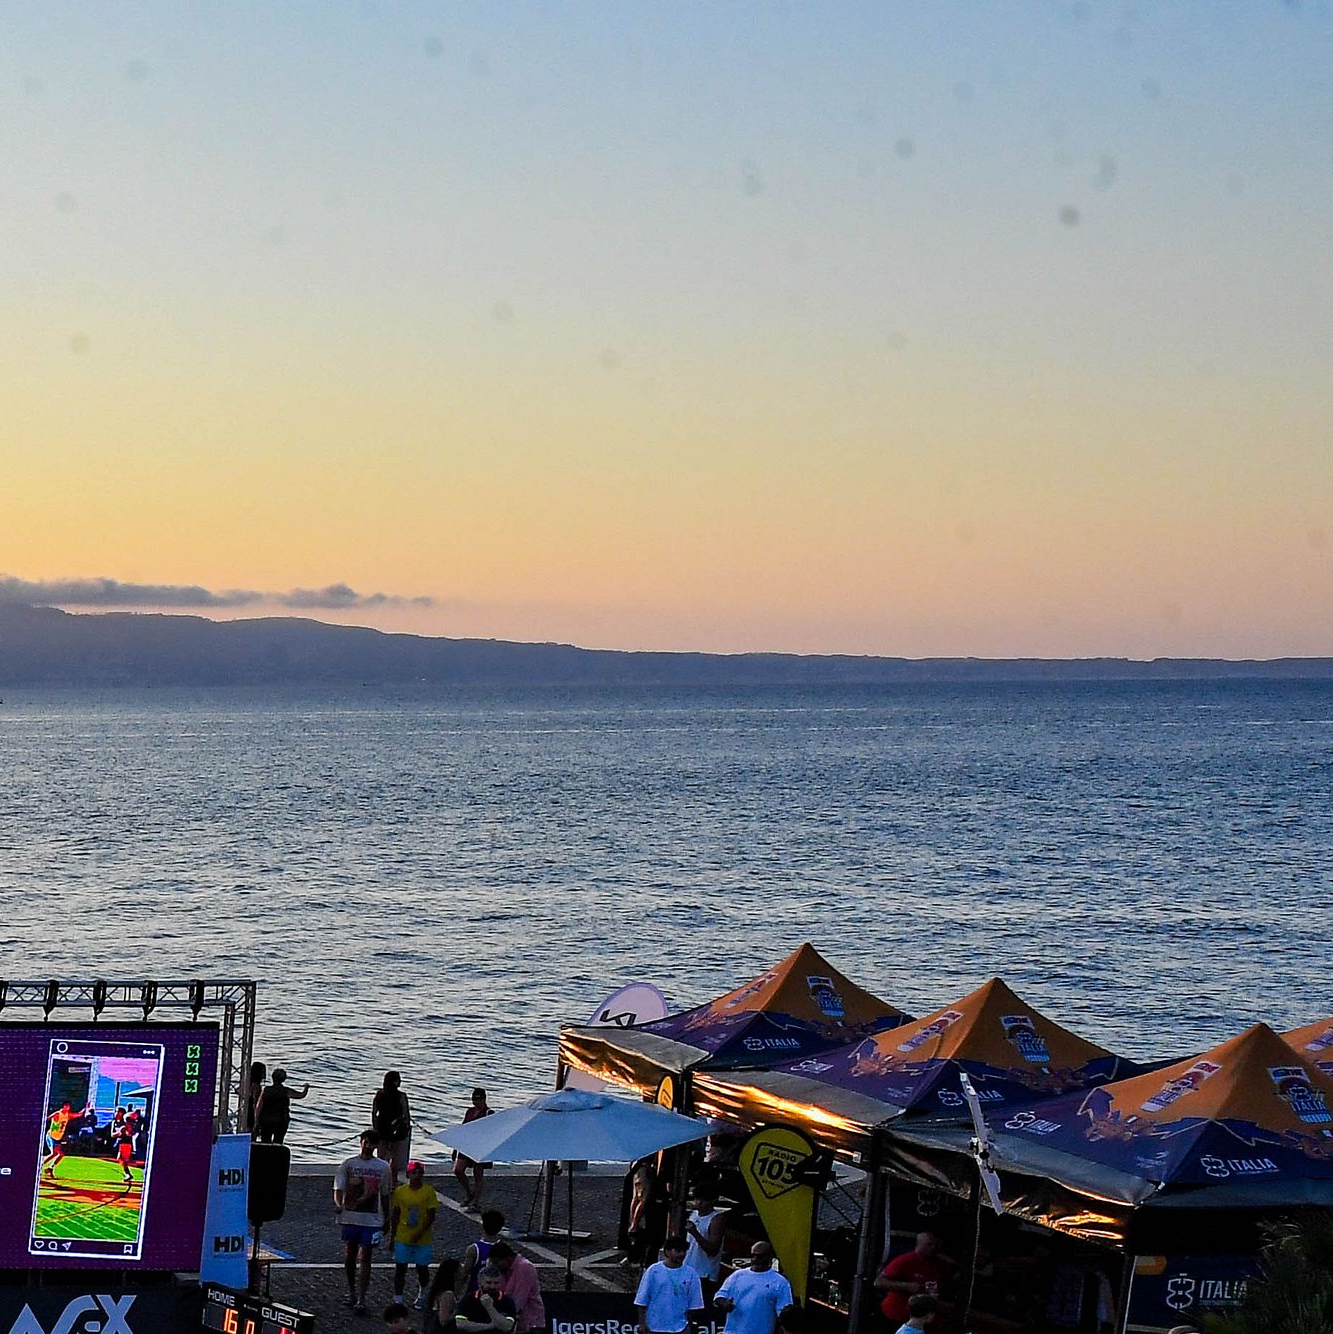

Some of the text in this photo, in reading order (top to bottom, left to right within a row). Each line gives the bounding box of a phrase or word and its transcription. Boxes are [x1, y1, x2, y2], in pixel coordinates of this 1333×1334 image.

[1228, 1158, 1278, 1171] ITALIA
[218, 1169, 244, 1186] HDI
[213, 1235, 244, 1253] HDI
[208, 1288, 235, 1307] HOME
[223, 1308, 238, 1334] 16
[261, 1307, 300, 1328] GUEST
